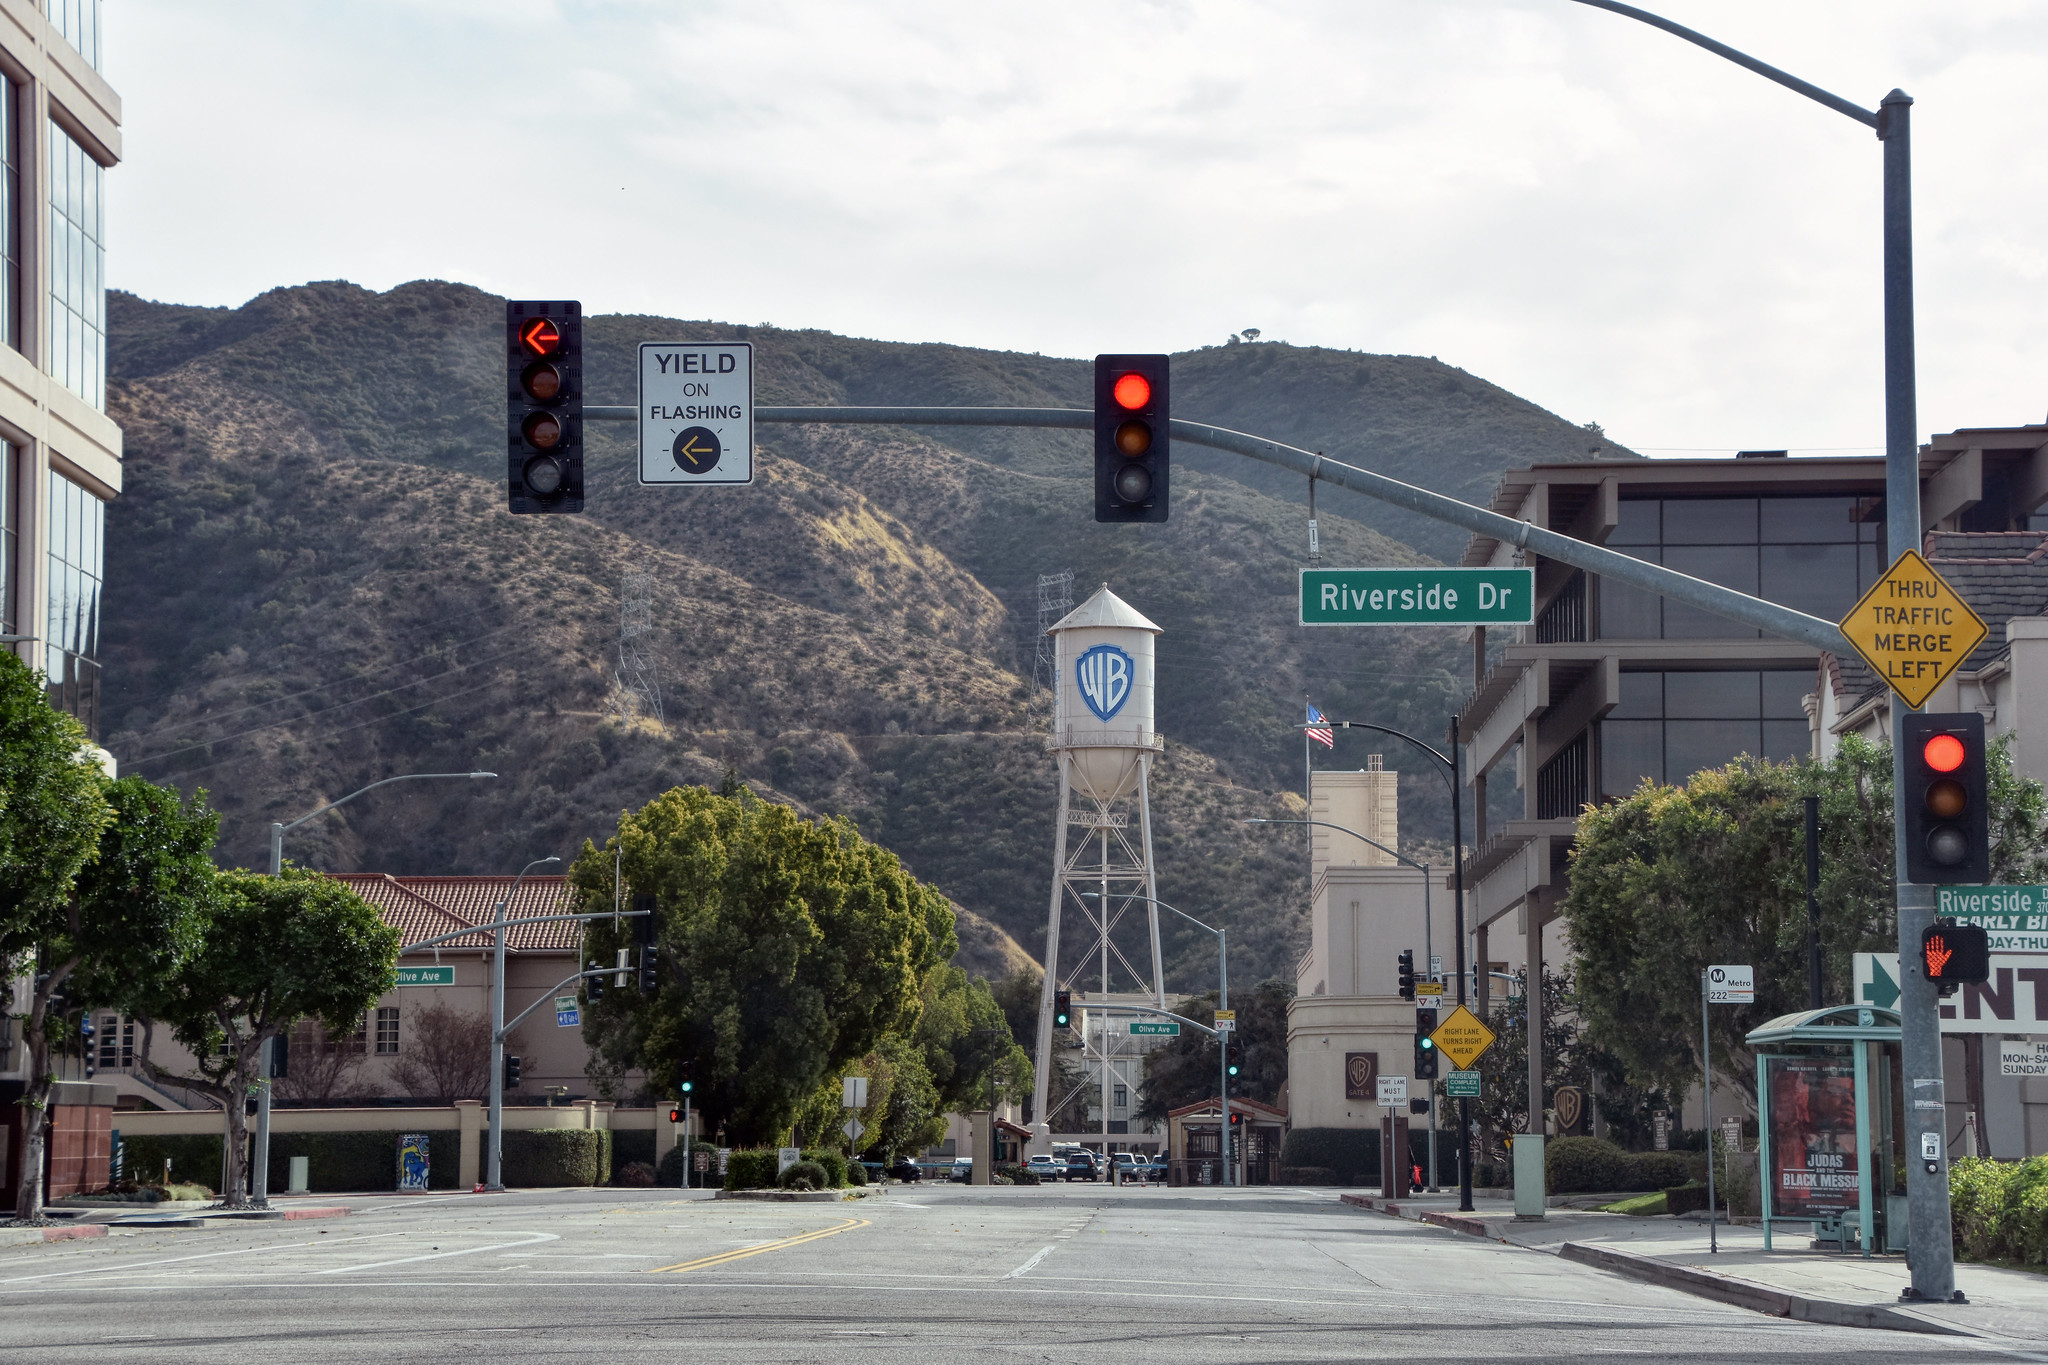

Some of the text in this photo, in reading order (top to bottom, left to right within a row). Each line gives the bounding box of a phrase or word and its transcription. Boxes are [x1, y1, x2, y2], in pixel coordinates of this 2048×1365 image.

[654, 353, 736, 374] YIELD
[683, 383, 709, 397] ON
[651, 405, 742, 420] FLASHING
[1321, 582, 1512, 611] Riverside Dr
[1886, 580, 1938, 599] THRU
[1873, 606, 1953, 626] TRAFFIC
[1875, 633, 1953, 652] MERGE
[1888, 660, 1943, 679] LEFT
[1080, 652, 1128, 713] WB
[1940, 889, 2032, 913] Riverside
[1956, 915, 2021, 930] EARLY
[421, 971, 440, 981] Ave
[1712, 970, 1724, 981] M
[1727, 979, 1751, 987] Metro
[1710, 991, 1728, 1000] 222
[1940, 967, 2048, 1021] NT
[1138, 1025, 1171, 1033] Olive Ave
[1452, 1047, 1473, 1055] AHEAD
[1448, 1072, 1479, 1080] MUSEUM
[2003, 1064, 2047, 1075] SUNDAY
[1383, 1087, 1401, 1095] MUST
[1807, 1153, 1844, 1168] JUDAS
[1782, 1173, 1818, 1188] BLACK
